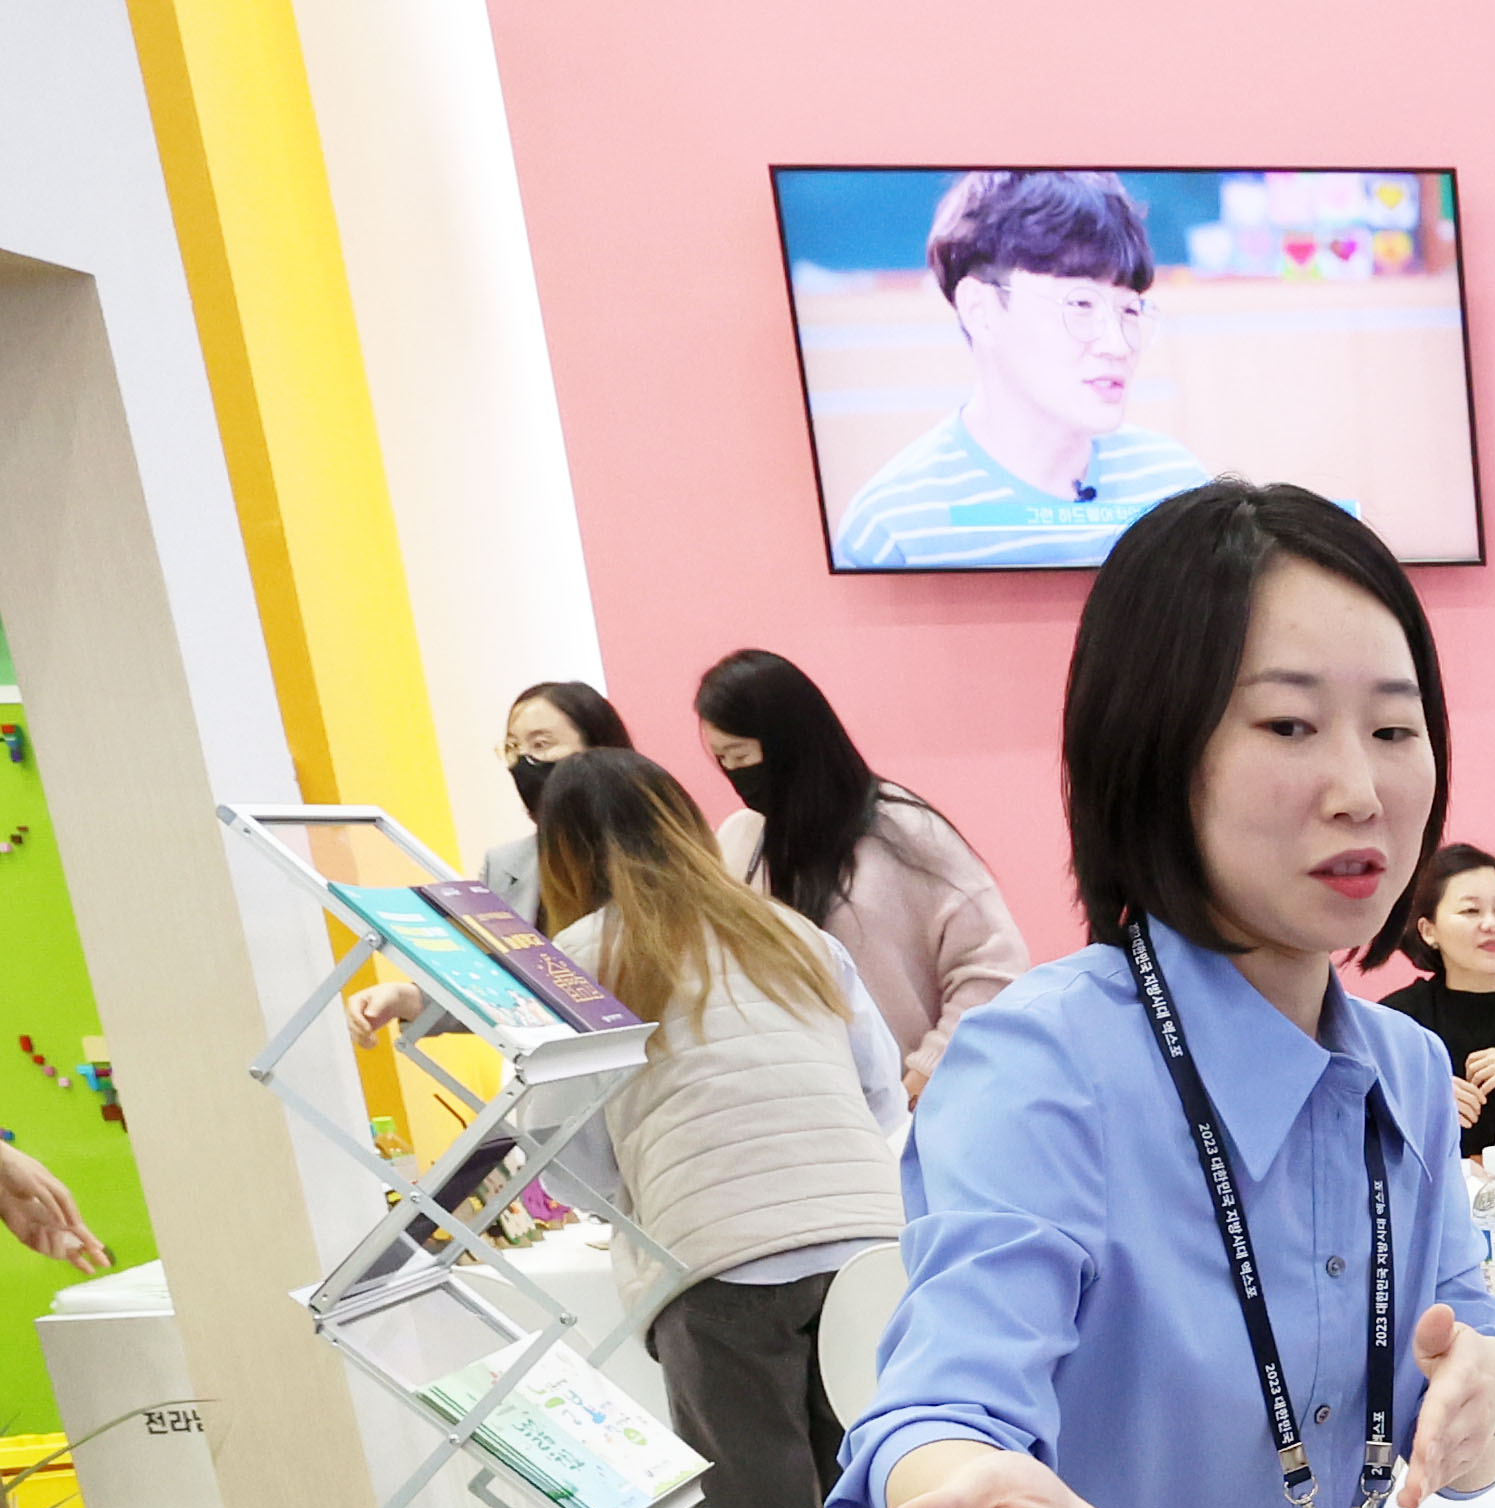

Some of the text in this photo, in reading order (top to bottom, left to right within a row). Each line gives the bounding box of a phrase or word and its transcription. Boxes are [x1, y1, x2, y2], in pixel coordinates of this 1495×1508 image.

[1143, 973, 1172, 1020] 지방시대
[1161, 1020, 1184, 1058] 엑스포
[1198, 1123, 1258, 1299] 2023 대한민국 지방시대 엑스포
[1376, 1180, 1389, 1348] 2023 대한민국 지방시대 엑스포
[1265, 1363, 1295, 1445] 2023 대한민국
